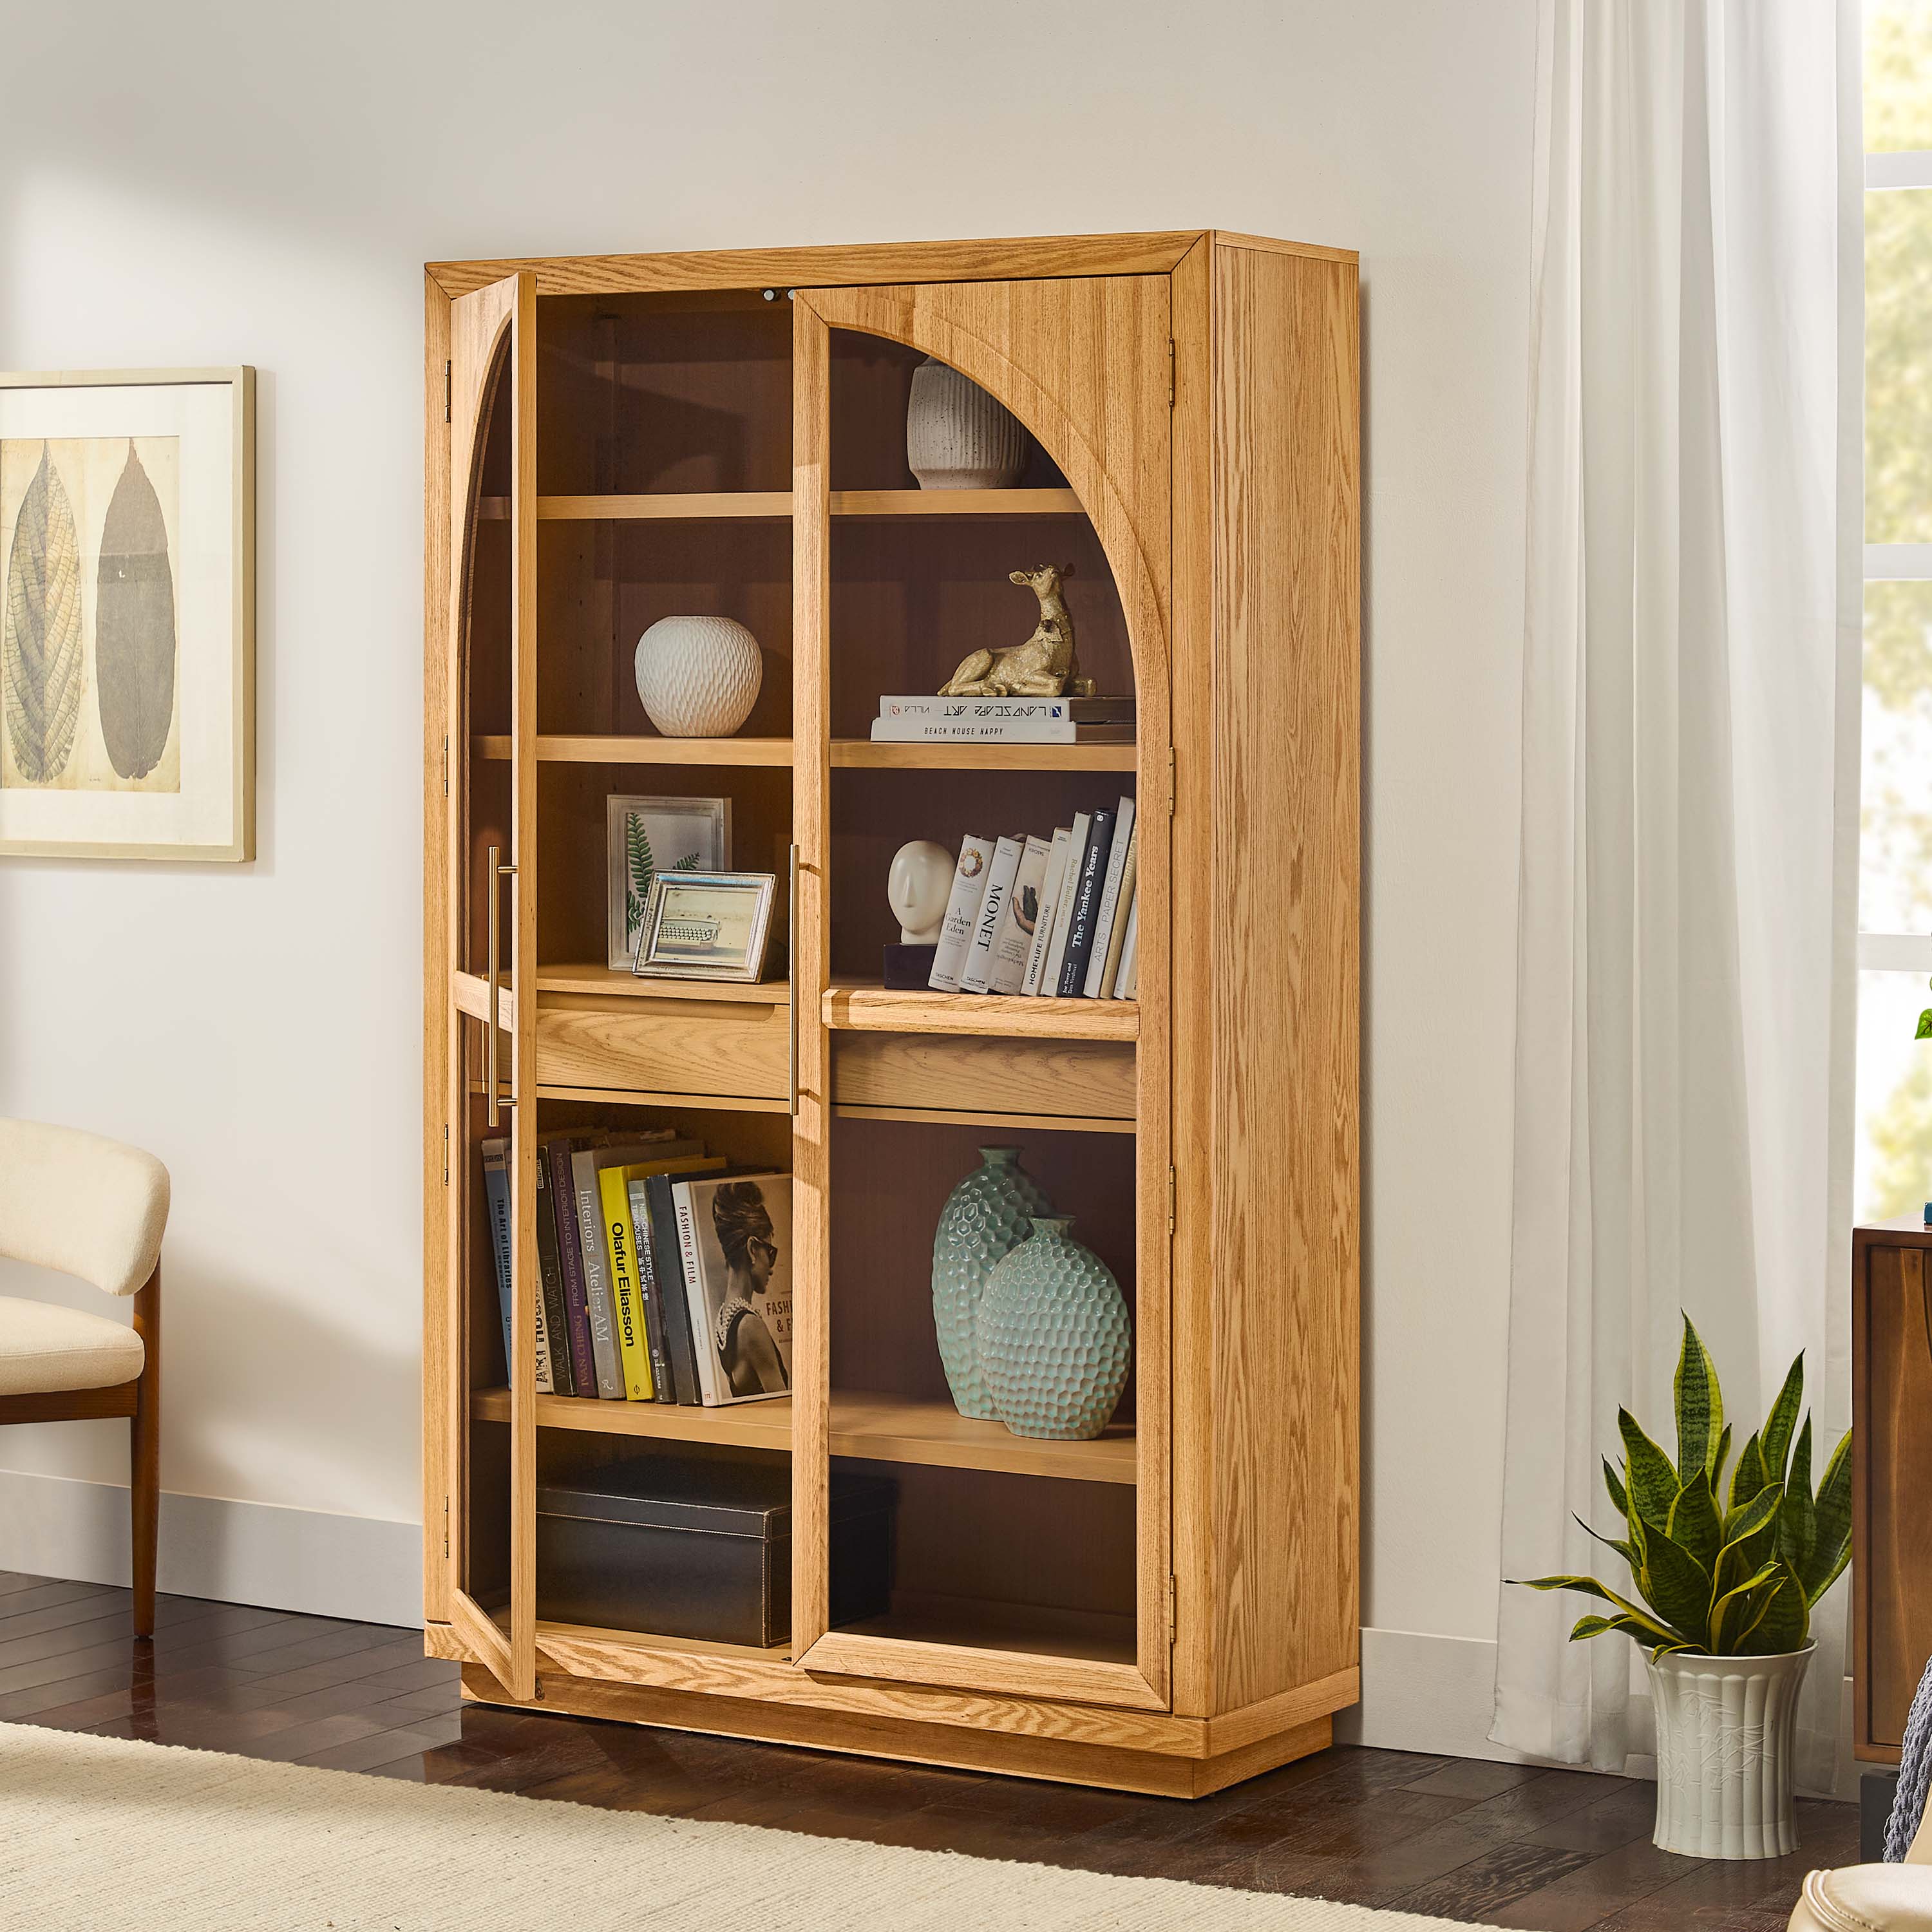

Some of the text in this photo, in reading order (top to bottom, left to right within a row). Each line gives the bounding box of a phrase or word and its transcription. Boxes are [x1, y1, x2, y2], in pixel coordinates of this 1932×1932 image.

[904, 705, 930, 714] VILLA
[943, 705, 968, 716] ART
[924, 727, 948, 735] BEACH
[954, 907, 962, 916] A
[1072, 845, 1099, 948] The Yankee Years
[1094, 932, 1106, 963] ARTS
[1102, 886, 1116, 923] PAPER
[1110, 839, 1124, 884] SECRET
[945, 914, 971, 927] Garden
[946, 923, 964, 935] Eden
[978, 884, 1003, 952] MONET
[1037, 904, 1051, 942] FURNITURE
[935, 972, 954, 981] TASCHEN
[966, 976, 985, 985] TASCHEN
[500, 1234, 508, 1244] of
[556, 1153, 580, 1307] FROM STAGE TO INTERIOR DESIGN
[632, 1204, 643, 1251] TEAHOUSES
[679, 1206, 692, 1248] FASHION
[687, 1261, 696, 1284] FILM
[502, 1245, 512, 1289] Libraries
[580, 1190, 609, 1343] Interiors Atelier AM
[645, 1256, 654, 1281] STYLE
[544, 1266, 559, 1310] WATCH
[612, 1222, 634, 1347] Olafur Eliasson
[550, 1314, 562, 1341] AND
[553, 1347, 566, 1380] WALK
